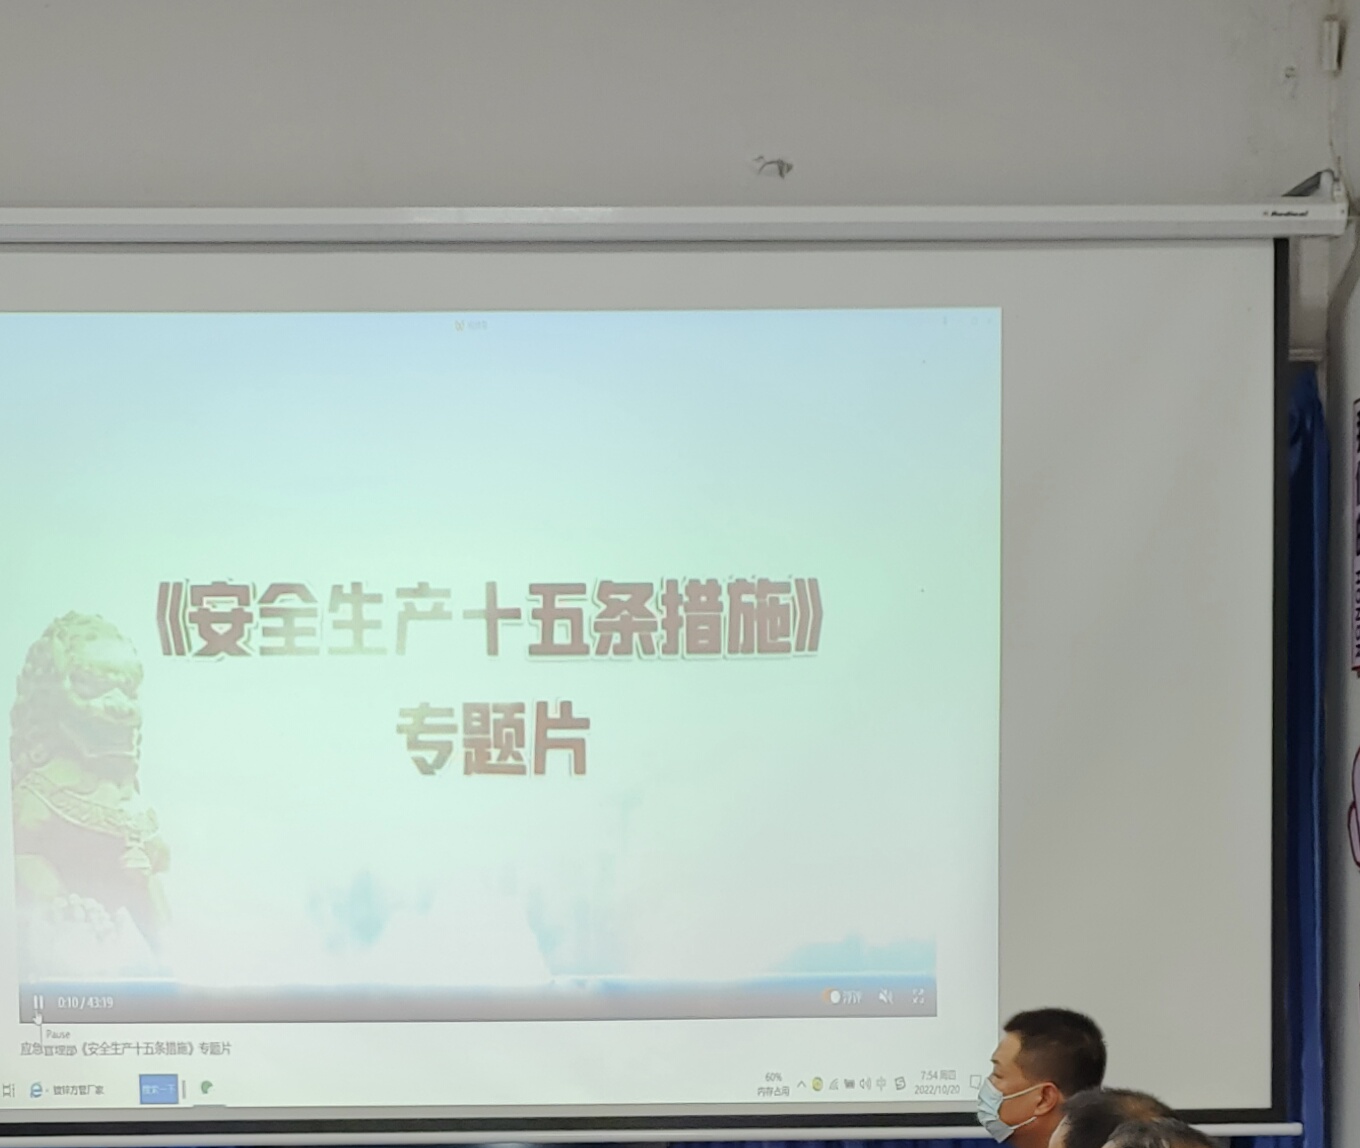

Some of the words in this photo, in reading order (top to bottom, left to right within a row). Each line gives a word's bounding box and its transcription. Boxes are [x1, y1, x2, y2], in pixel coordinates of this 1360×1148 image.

[155, 576, 824, 661] 《安全生产十五条措施》
[395, 699, 591, 779] 专题片
[46, 1029, 70, 1039] Pause
